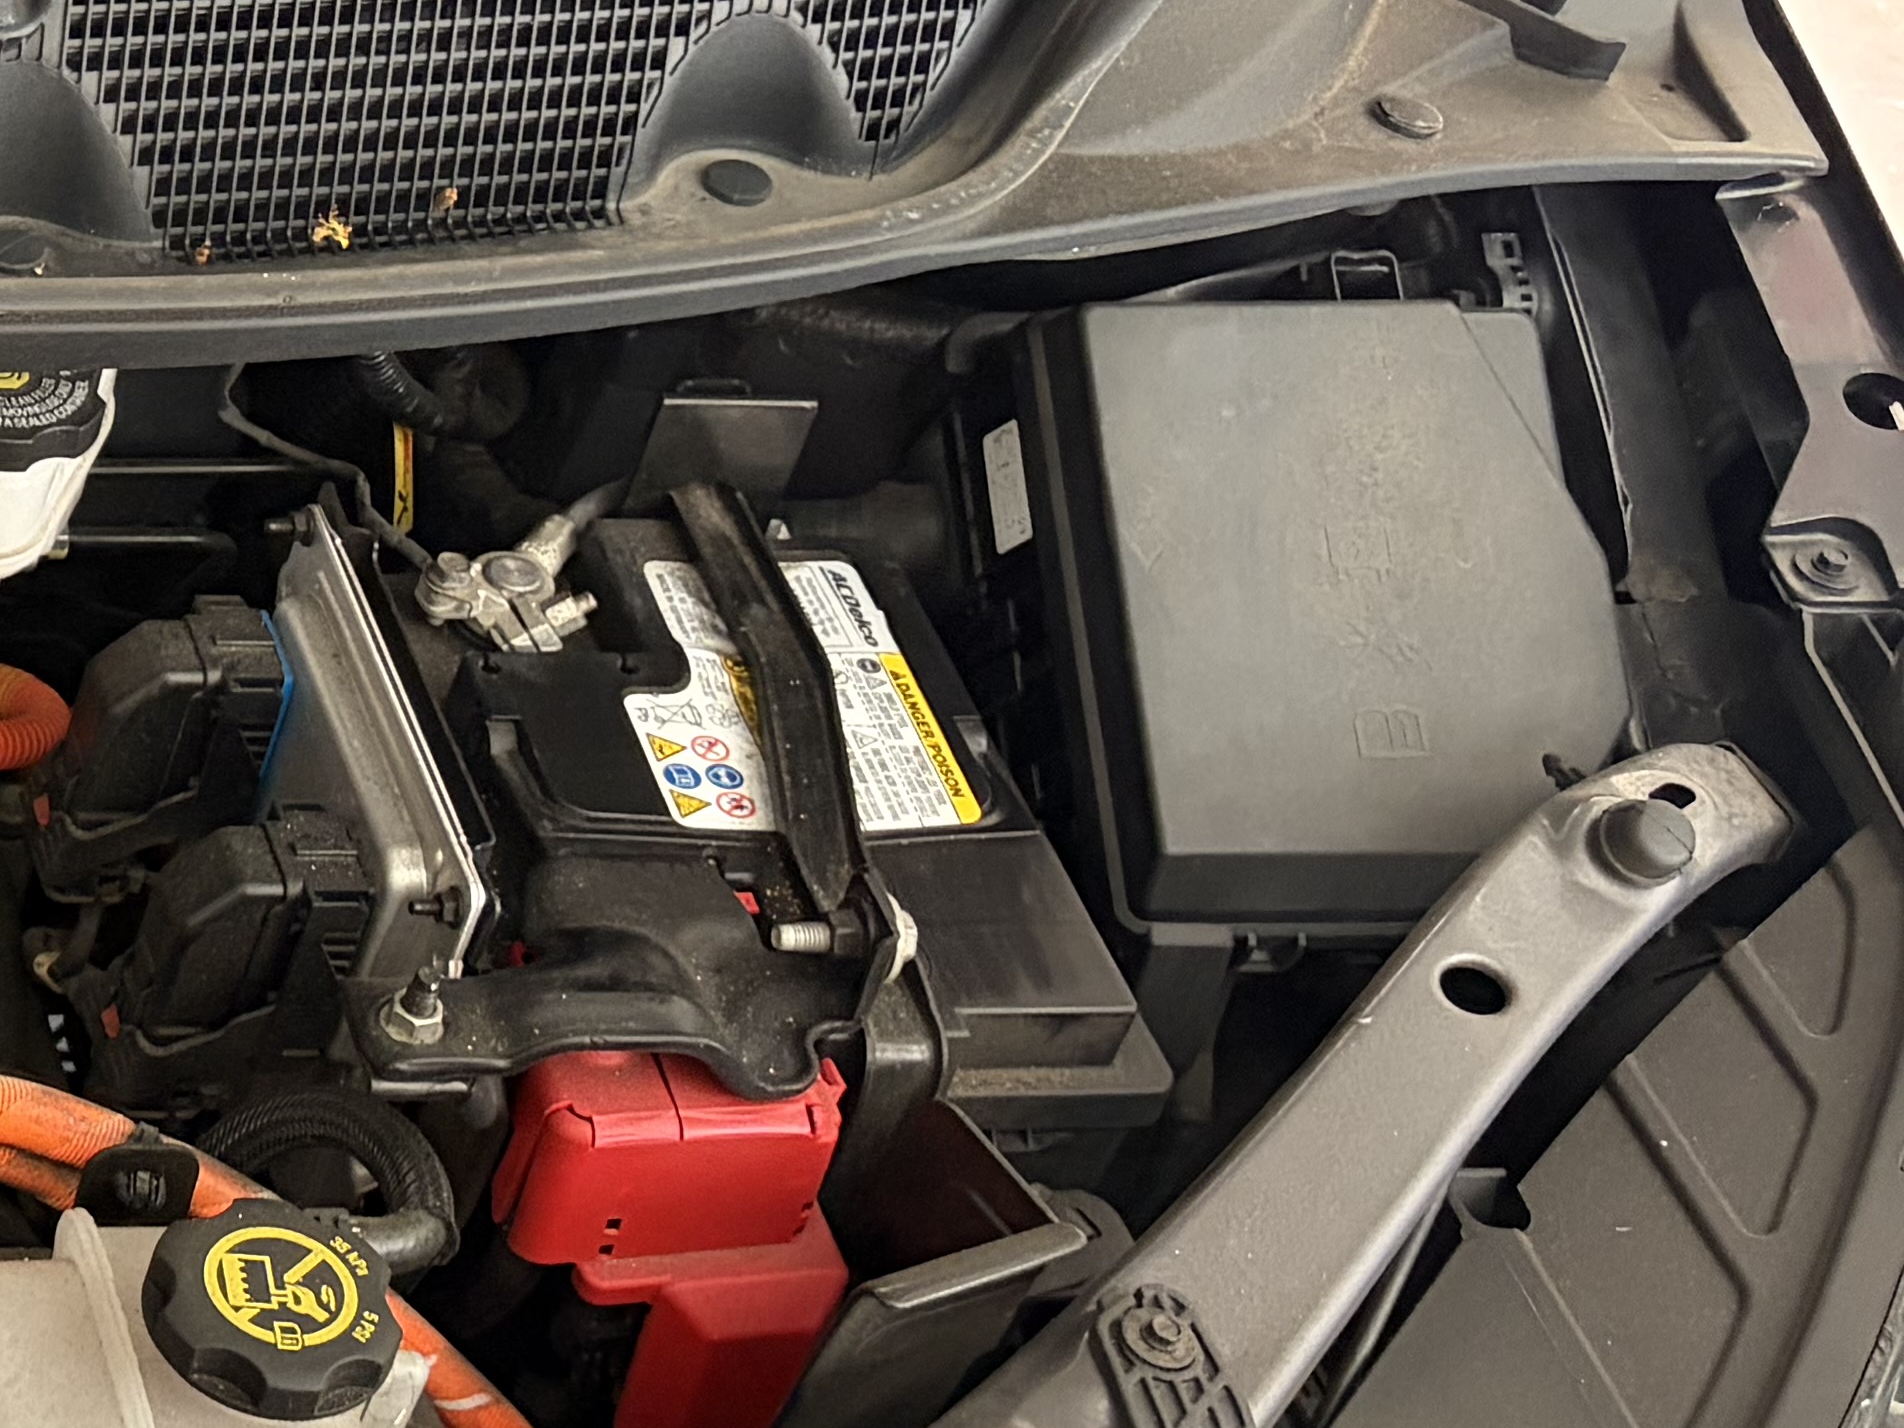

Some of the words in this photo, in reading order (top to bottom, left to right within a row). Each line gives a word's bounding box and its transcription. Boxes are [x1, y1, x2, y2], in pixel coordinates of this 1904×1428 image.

[4, 417, 13, 428] A
[14, 412, 57, 428] SEALED
[828, 568, 878, 648] ACDelco
[330, 1236, 352, 1253] 35
[363, 1310, 380, 1323] 5
[352, 1320, 375, 1343] PSI
